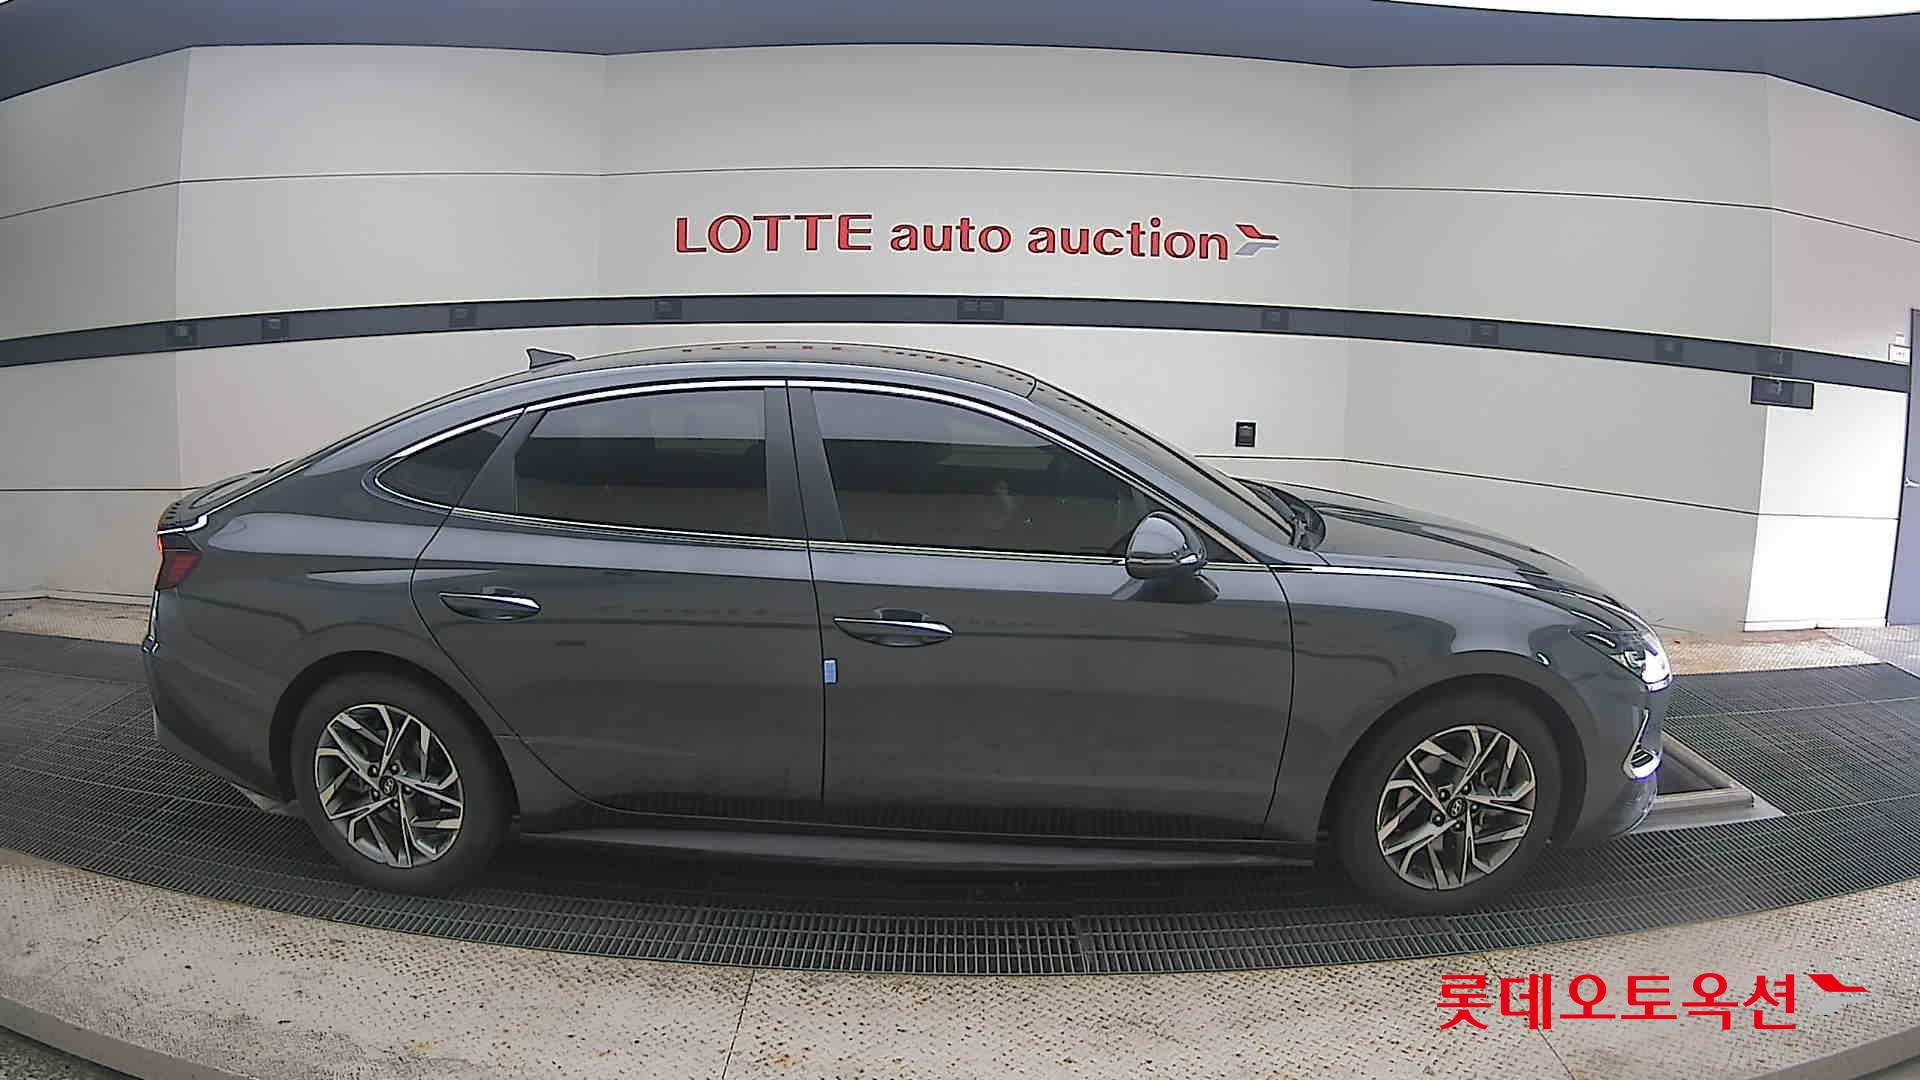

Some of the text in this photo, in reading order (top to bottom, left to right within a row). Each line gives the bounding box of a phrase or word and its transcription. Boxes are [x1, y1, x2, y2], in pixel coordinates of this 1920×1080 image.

[675, 214, 1229, 260] LOTTE auto auction
